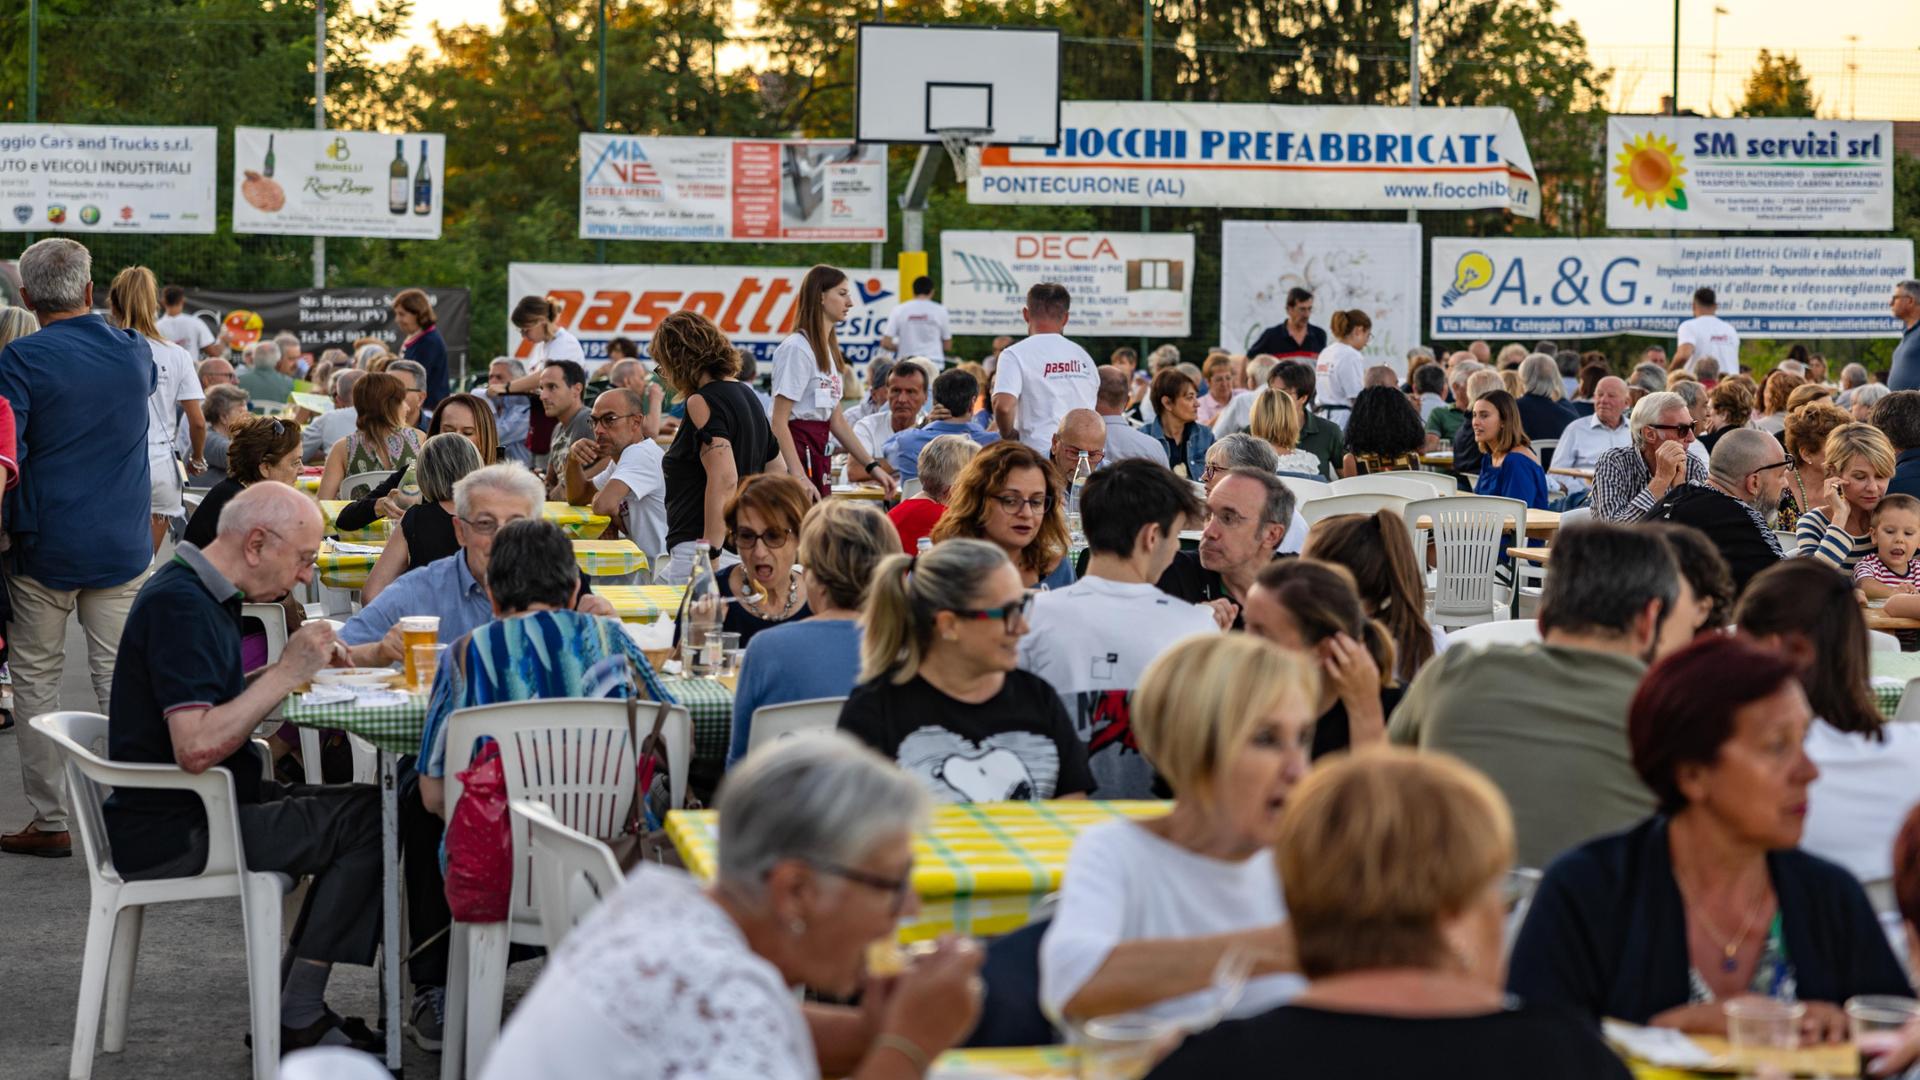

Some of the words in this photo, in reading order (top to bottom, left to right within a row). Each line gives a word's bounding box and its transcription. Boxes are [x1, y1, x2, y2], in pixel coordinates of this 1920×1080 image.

[40, 135, 74, 149] Cars
[77, 135, 106, 150] and
[109, 137, 159, 151] Trucks
[163, 138, 193, 151] s.r.l.
[1045, 128, 1187, 159] IOCCHI
[1694, 132, 1738, 158] SM
[1746, 130, 1839, 158] servizi
[1847, 133, 1881, 158] srl
[30, 163, 38, 172] e
[42, 160, 97, 174] VEICOLI
[101, 160, 191, 176] INDUSTRIALI
[315, 163, 363, 173] BRUNELLI
[983, 176, 1140, 194] PONTECURONE
[1146, 178, 1186, 198] (AL)
[1016, 236, 1119, 260] DECA
[1680, 247, 1732, 262] Impianti
[1734, 248, 1780, 260] Elettrici
[1782, 248, 1812, 260] Civili
[1656, 265, 1697, 278] Impianti
[1879, 269, 1906, 280] acque
[1724, 282, 1779, 295] d'allarme
[300, 296, 319, 309] Str.
[1742, 298, 1796, 312] Domotica
[300, 309, 358, 323] Retorbido
[360, 309, 388, 323] (PV)
[1441, 318, 1459, 331] Via
[1460, 318, 1494, 331] Milano
[1495, 318, 1502, 331] 7
[1511, 319, 1562, 334] Casteggio
[1563, 319, 1586, 333] (PV)
[1593, 318, 1610, 331] Tel.
[300, 332, 320, 344] Tel.
[322, 332, 344, 344] 345
